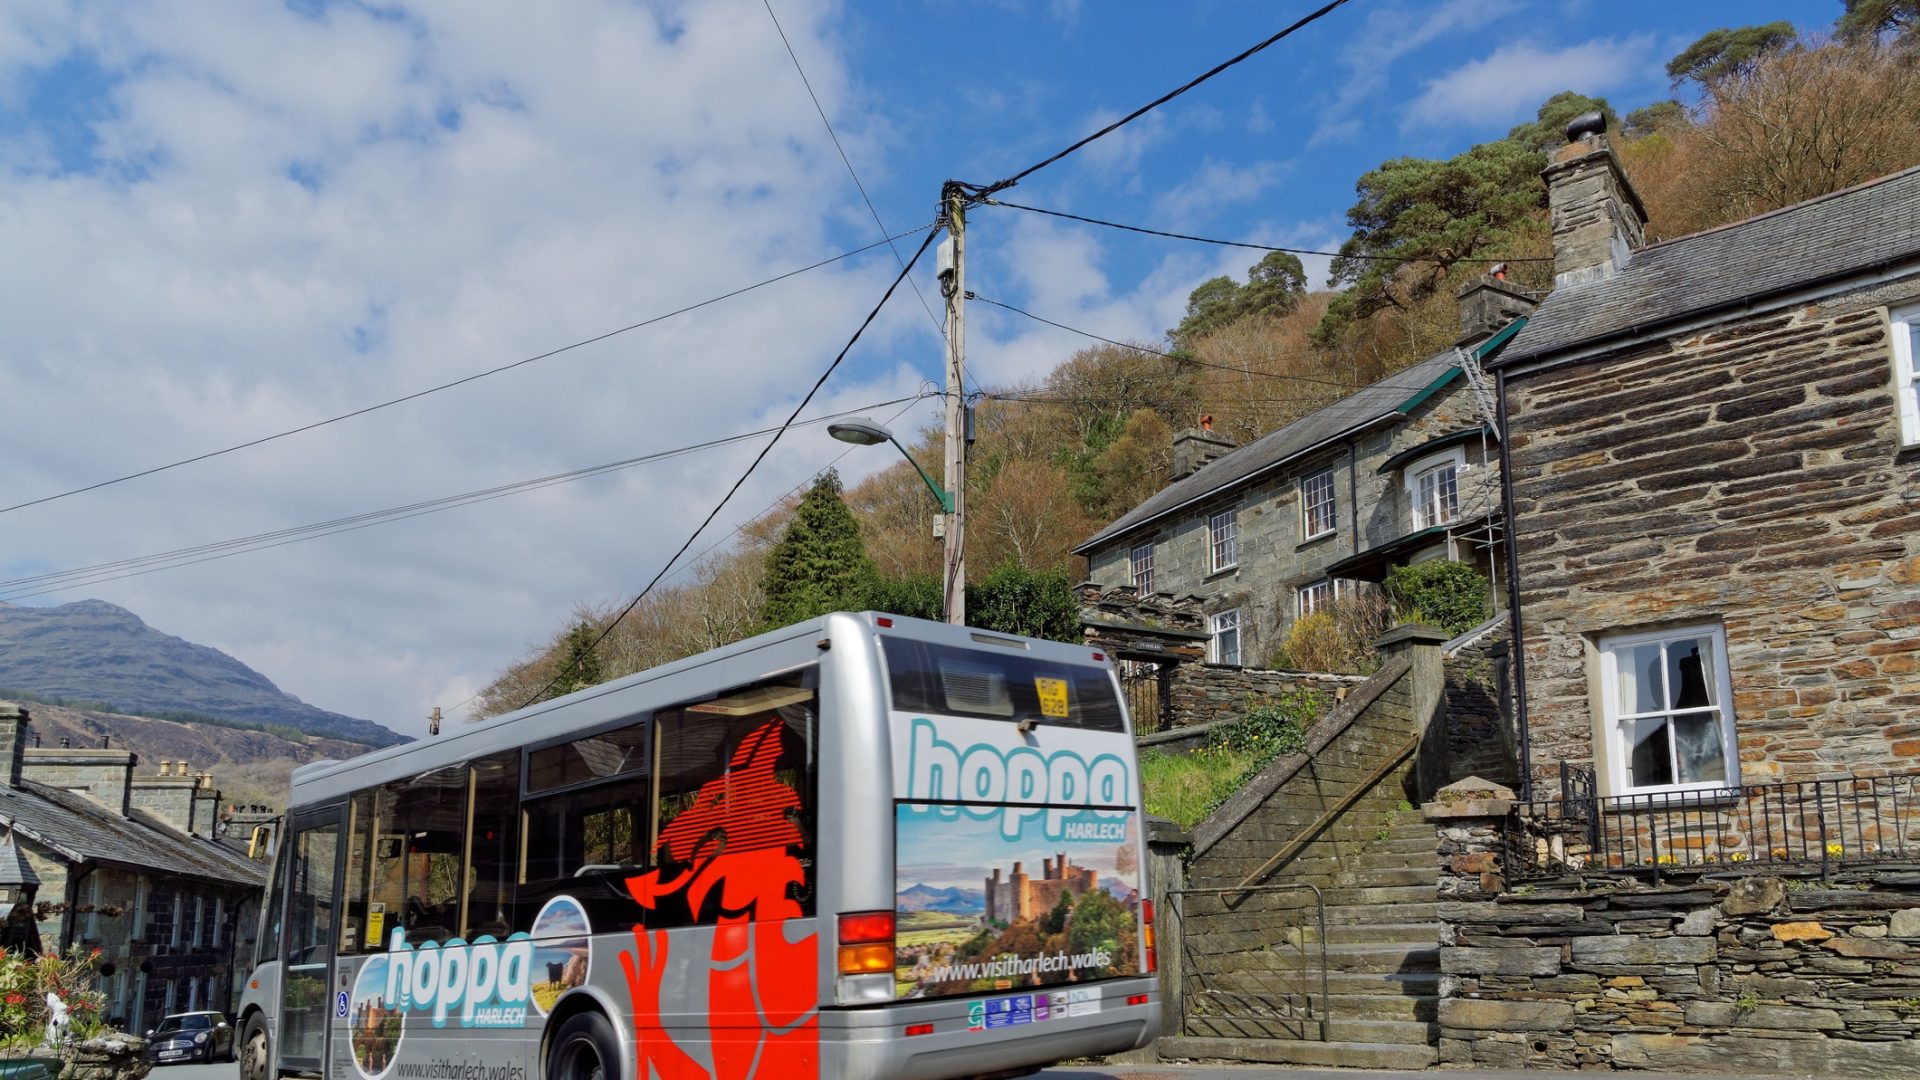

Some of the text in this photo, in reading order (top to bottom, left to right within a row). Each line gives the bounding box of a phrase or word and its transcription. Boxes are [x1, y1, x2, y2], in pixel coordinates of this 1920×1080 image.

[909, 718, 1128, 842] hoppa
[1065, 822, 1126, 840] HARLECH
[384, 926, 534, 1028] hoppa
[933, 947, 1112, 983] www.visitharlech.wales
[475, 1007, 525, 1025] HARLECH
[397, 1058, 524, 1080] www.visitharlech.wales
